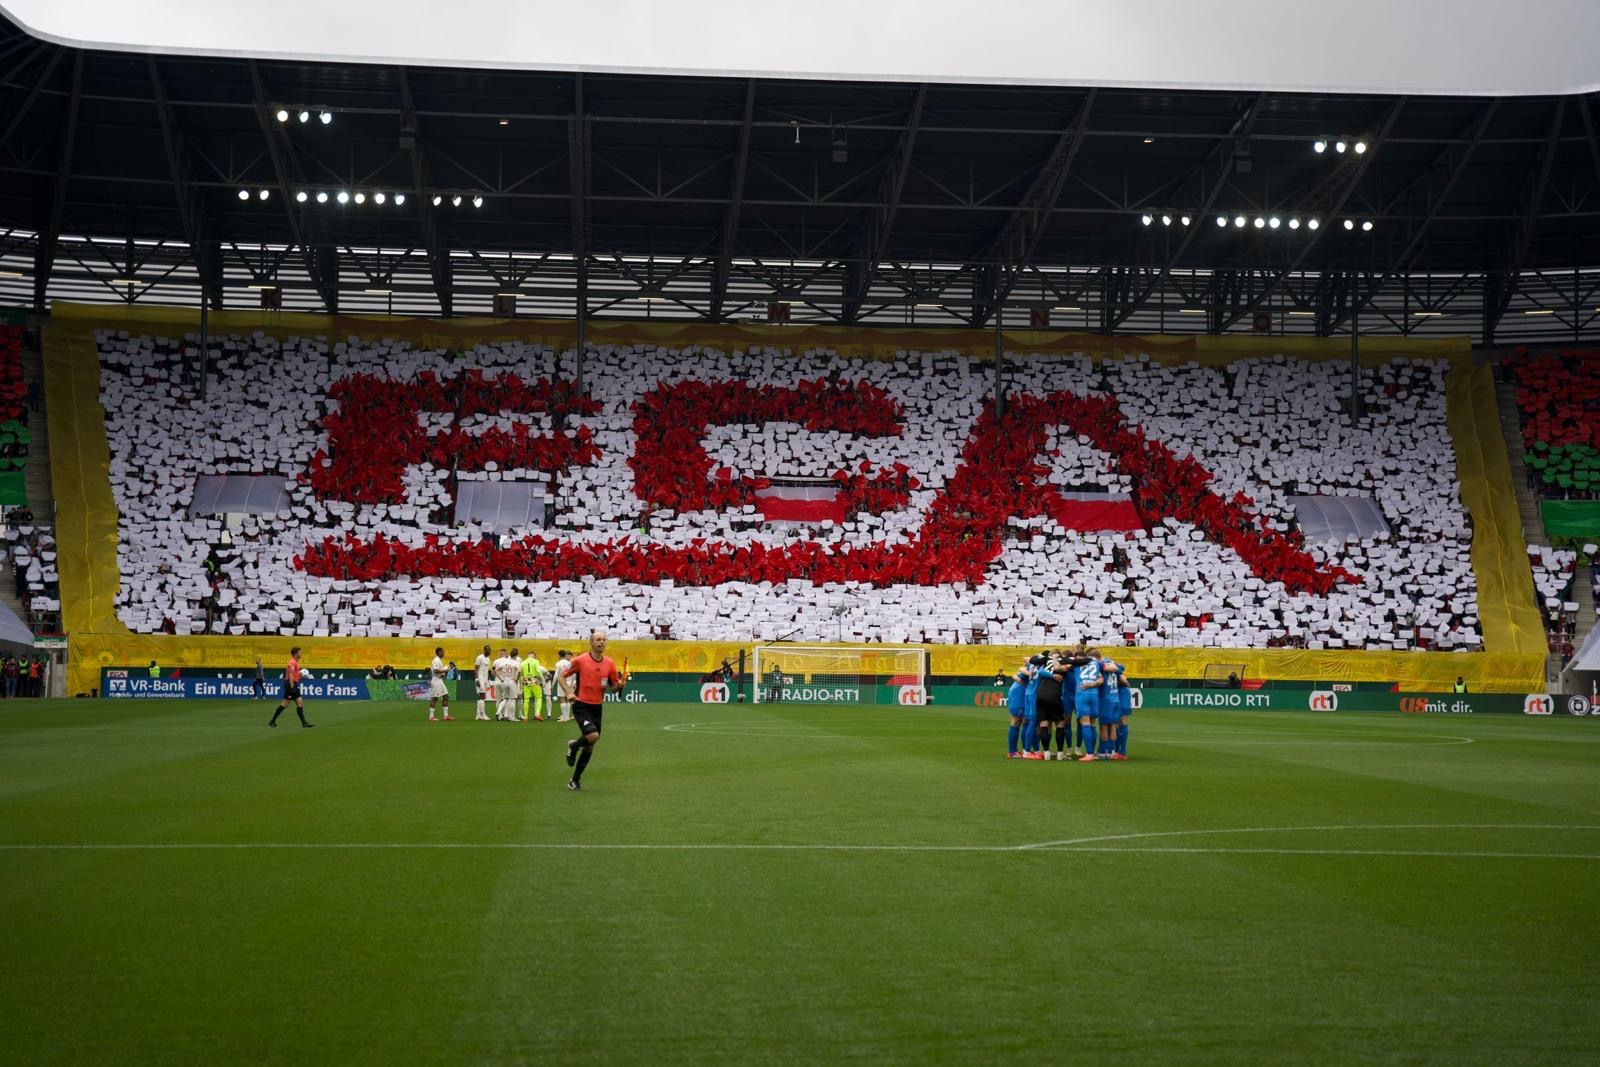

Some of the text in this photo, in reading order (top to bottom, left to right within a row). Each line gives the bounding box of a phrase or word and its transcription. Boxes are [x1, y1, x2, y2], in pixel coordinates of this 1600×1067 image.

[1080, 664, 1097, 679] 22
[129, 679, 186, 691] VR-Bank
[194, 682, 216, 695] Ein
[220, 682, 255, 696] Muss
[326, 685, 358, 697] Fans
[625, 689, 648, 703] dir.
[704, 686, 727, 702] rt1
[835, 689, 860, 701] RT1
[1169, 693, 1271, 707] HITRADIO RT1
[1312, 694, 1335, 710] rt1
[1451, 700, 1474, 714] dir.
[1528, 697, 1551, 712] rt1
